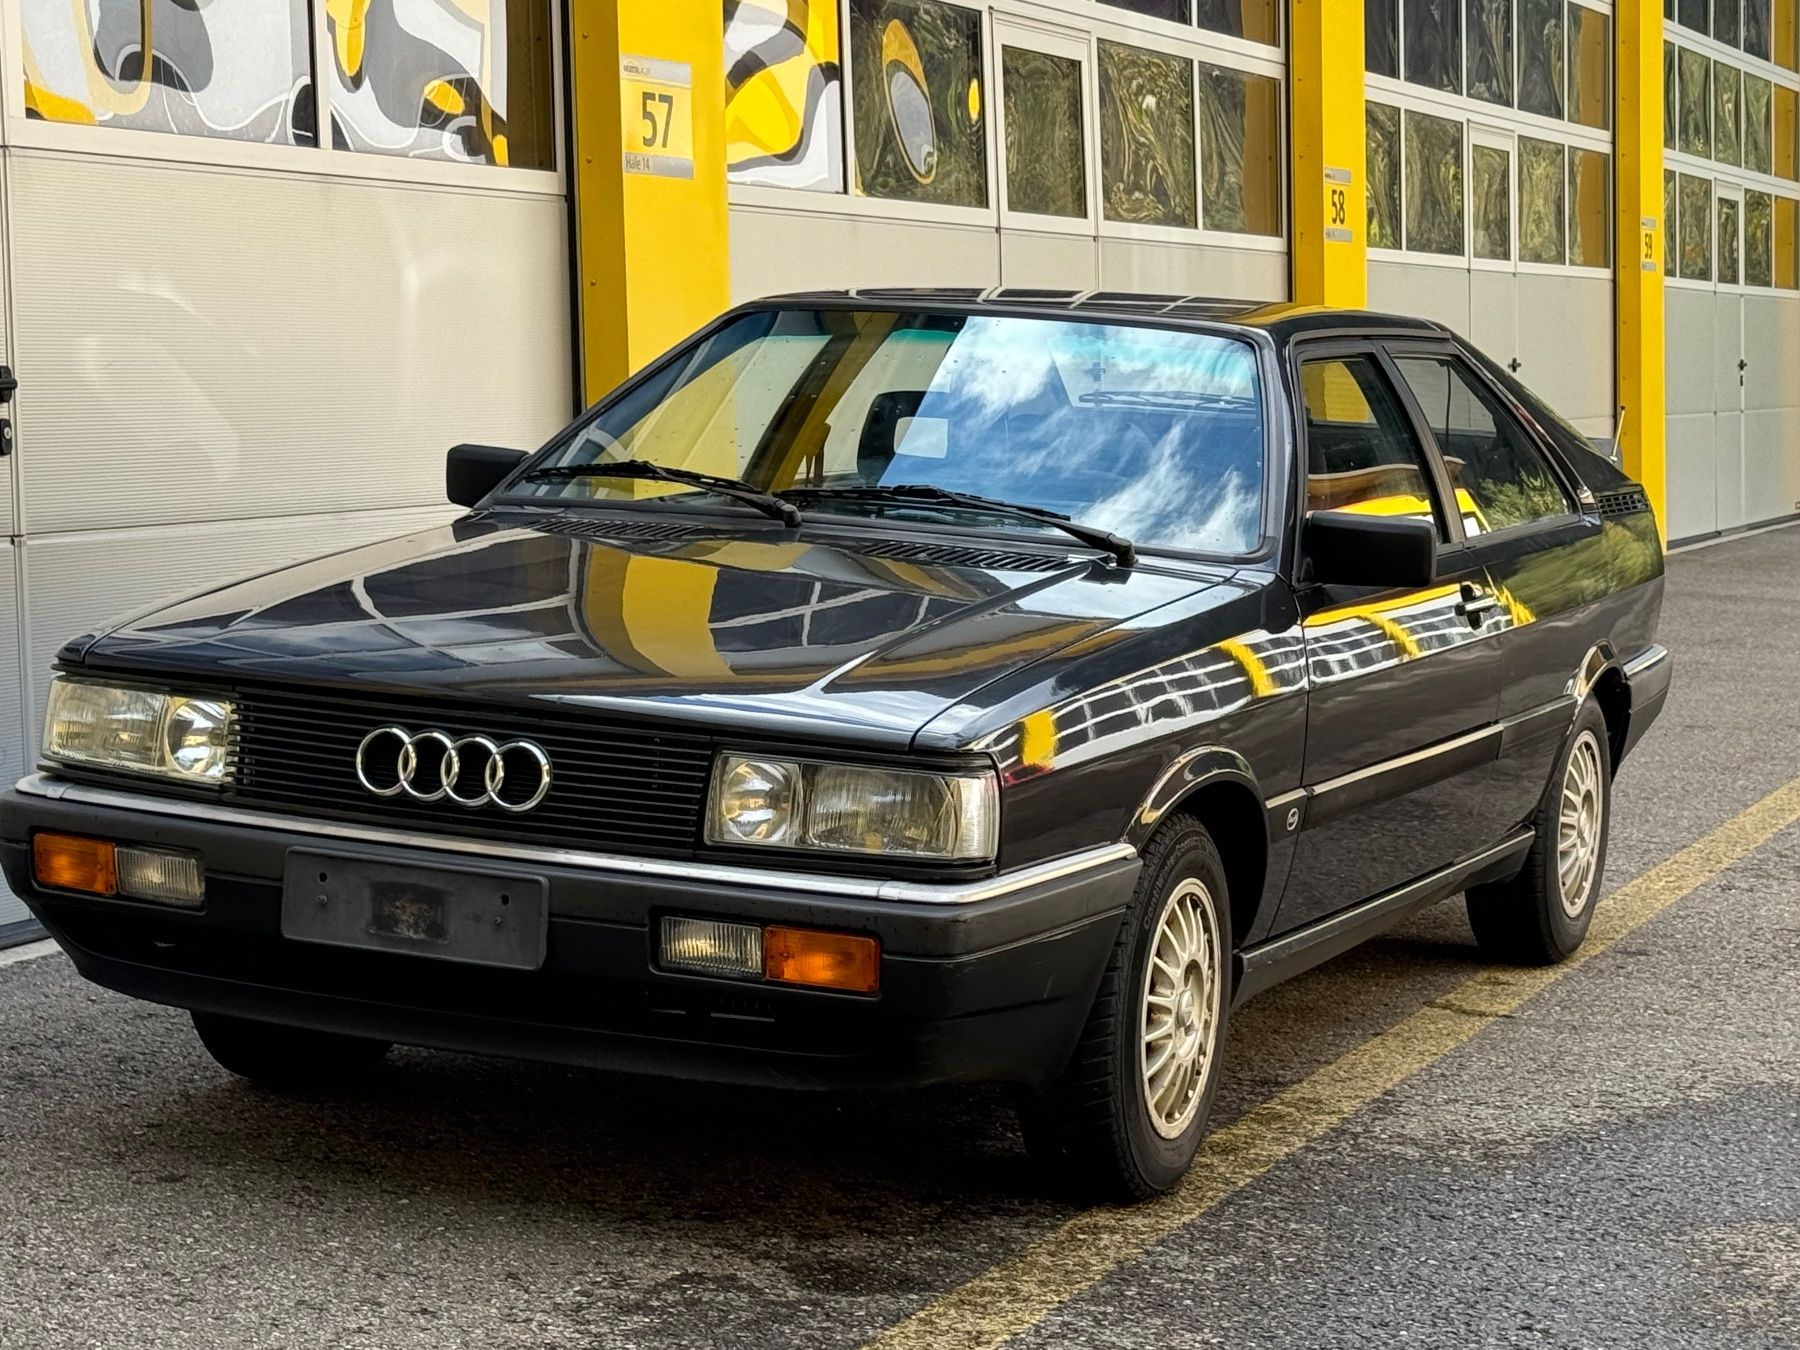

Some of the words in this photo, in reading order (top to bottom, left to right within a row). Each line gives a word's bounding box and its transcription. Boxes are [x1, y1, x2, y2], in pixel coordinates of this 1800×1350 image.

[642, 91, 673, 148] 57
[642, 156, 650, 172] 14
[1331, 188, 1346, 225] 58
[1644, 232, 1653, 260] 59
